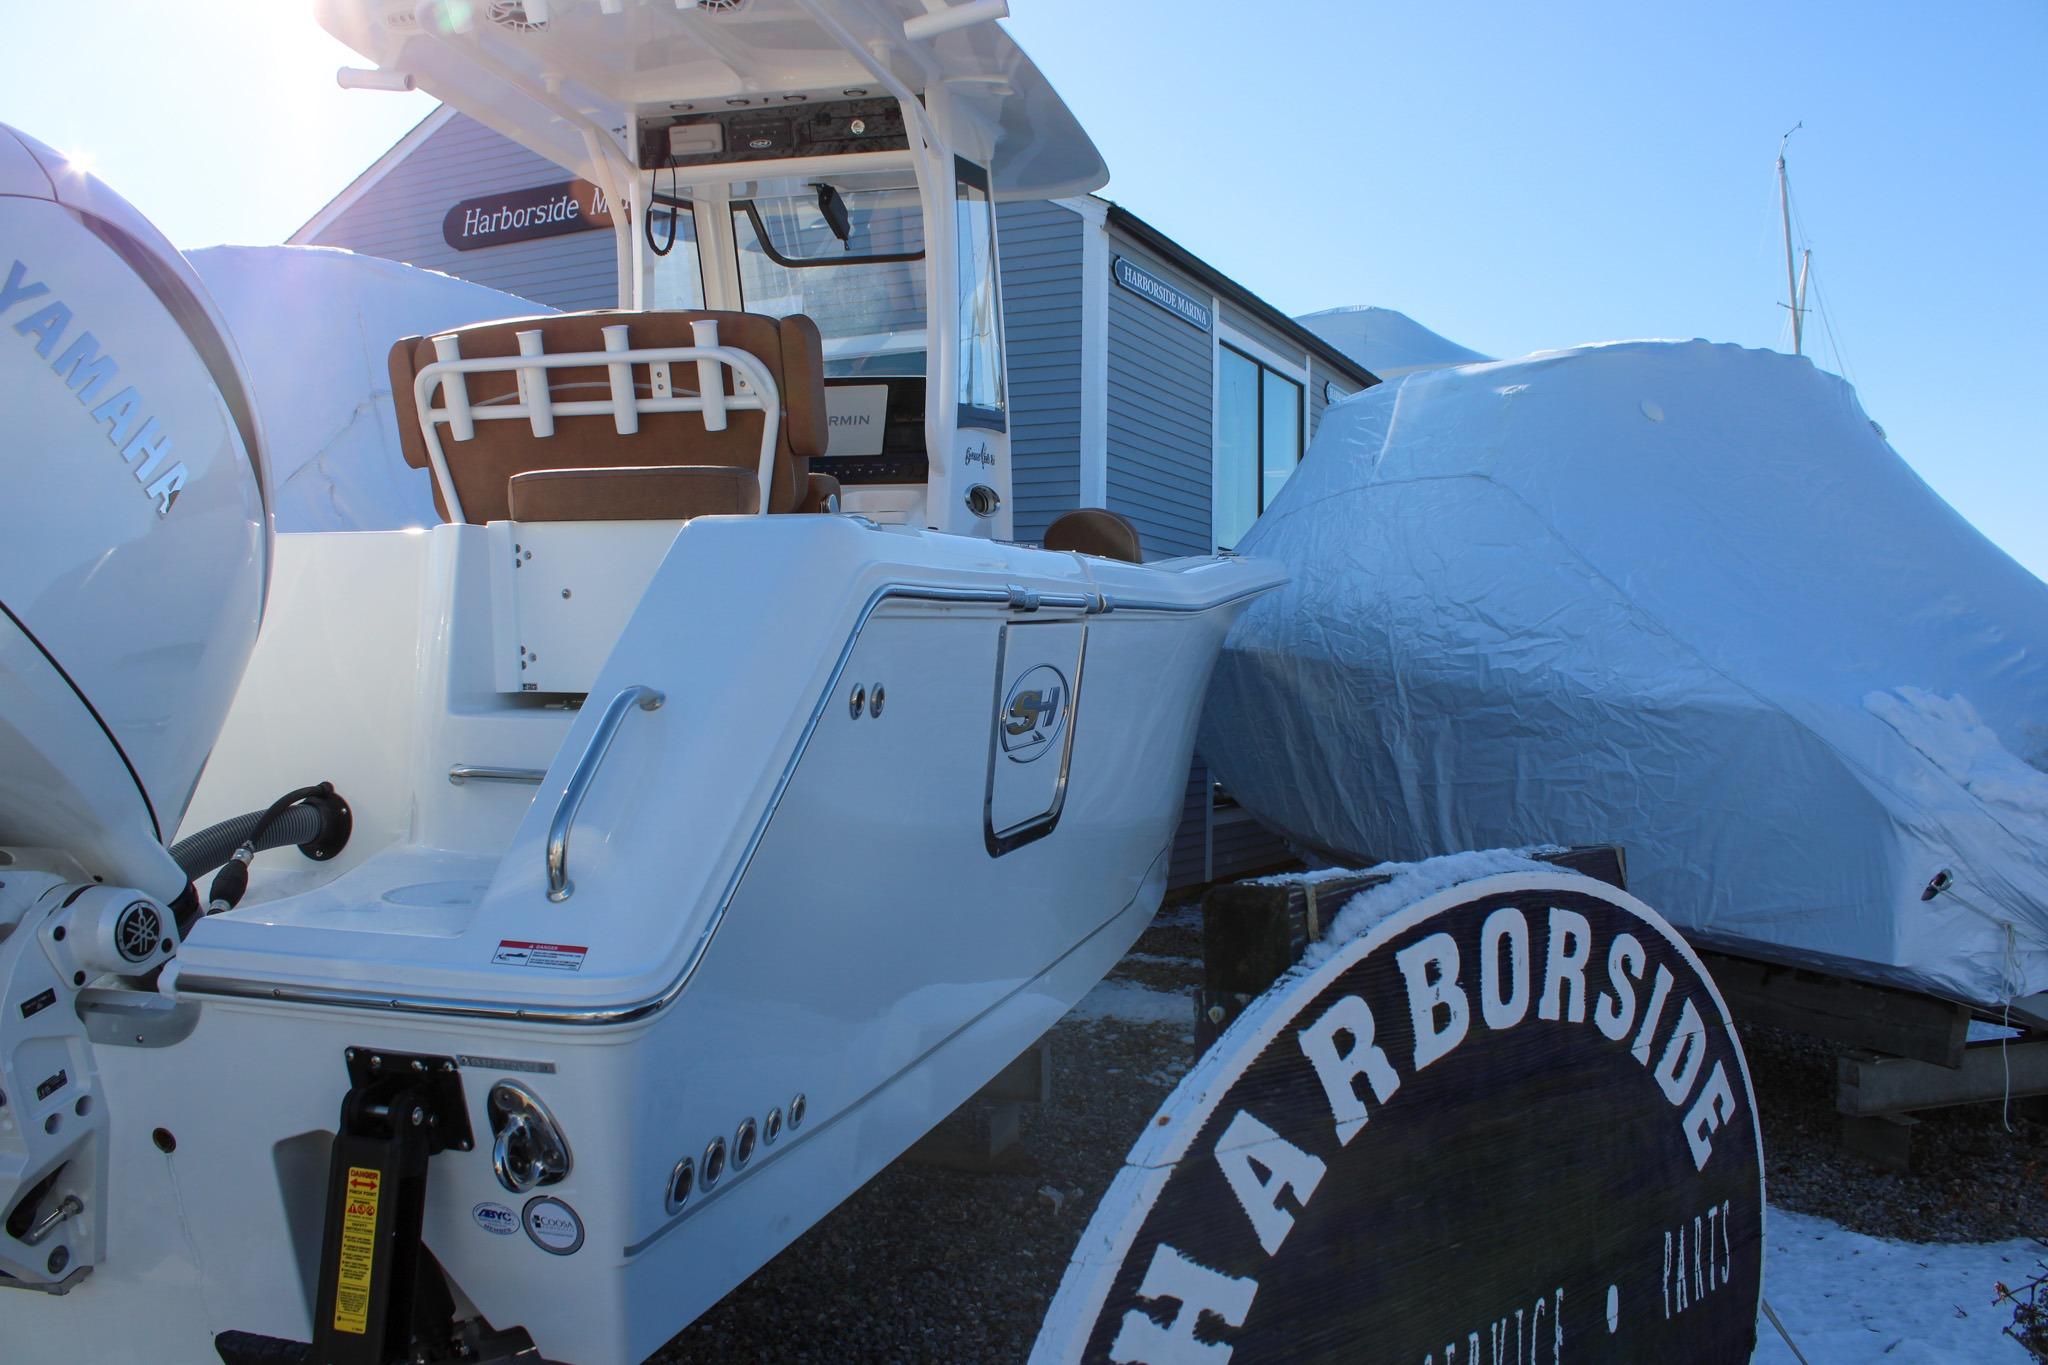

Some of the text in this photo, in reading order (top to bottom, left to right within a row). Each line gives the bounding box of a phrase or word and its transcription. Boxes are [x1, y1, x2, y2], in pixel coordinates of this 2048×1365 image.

[463, 196, 579, 237] Harborside
[1124, 265, 1207, 326] HARBORSIDE MARINA
[0, 259, 189, 520] YAMAHA
[828, 415, 870, 426] RMIN
[1109, 906, 1736, 1365] HARBORSIDE
[1662, 1200, 1731, 1320] PARTS
